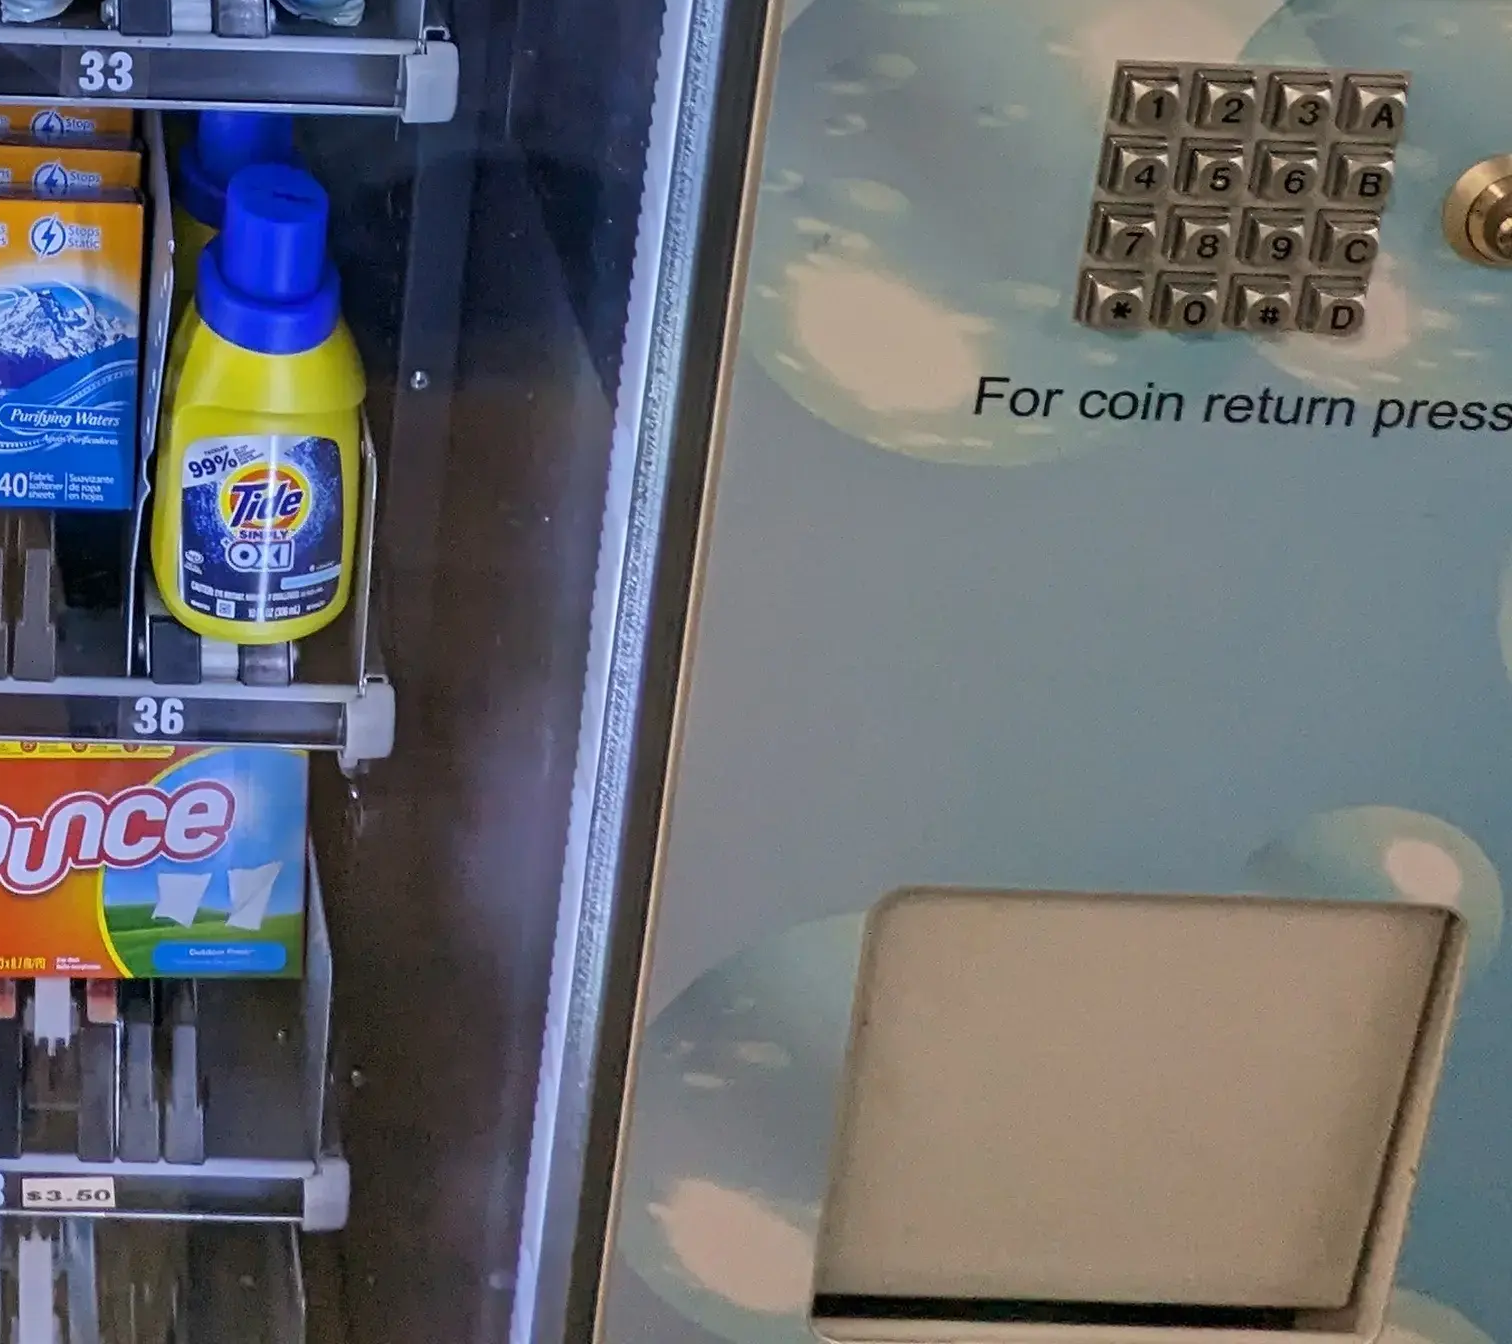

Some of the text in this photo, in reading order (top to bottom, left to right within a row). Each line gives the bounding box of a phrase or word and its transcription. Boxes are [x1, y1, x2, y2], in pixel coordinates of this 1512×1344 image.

[79, 50, 133, 91] 33
[1150, 96, 1396, 129] 1 2 3 A
[70, 172, 100, 183] Stops
[1134, 165, 1382, 197] 4 5 6 B
[68, 225, 100, 238] Stops
[68, 238, 100, 249] Static
[1124, 231, 1368, 264] 7 8 9 C
[1329, 305, 1354, 331] D
[973, 375, 1512, 438] For coin return press
[10, 407, 120, 428] Purifying Waters
[188, 451, 238, 478] 99%
[29, 472, 54, 482] Fabric
[69, 473, 114, 484] Suavizante
[29, 481, 63, 492] softener
[29, 490, 56, 500] sheets
[69, 484, 101, 494] de ropa
[68, 492, 104, 502] en hojas
[230, 479, 305, 528] Tide
[240, 531, 289, 540] SIMLY
[229, 540, 292, 569] OXI
[133, 697, 184, 734] 36
[26, 1188, 111, 1203] $3.50
